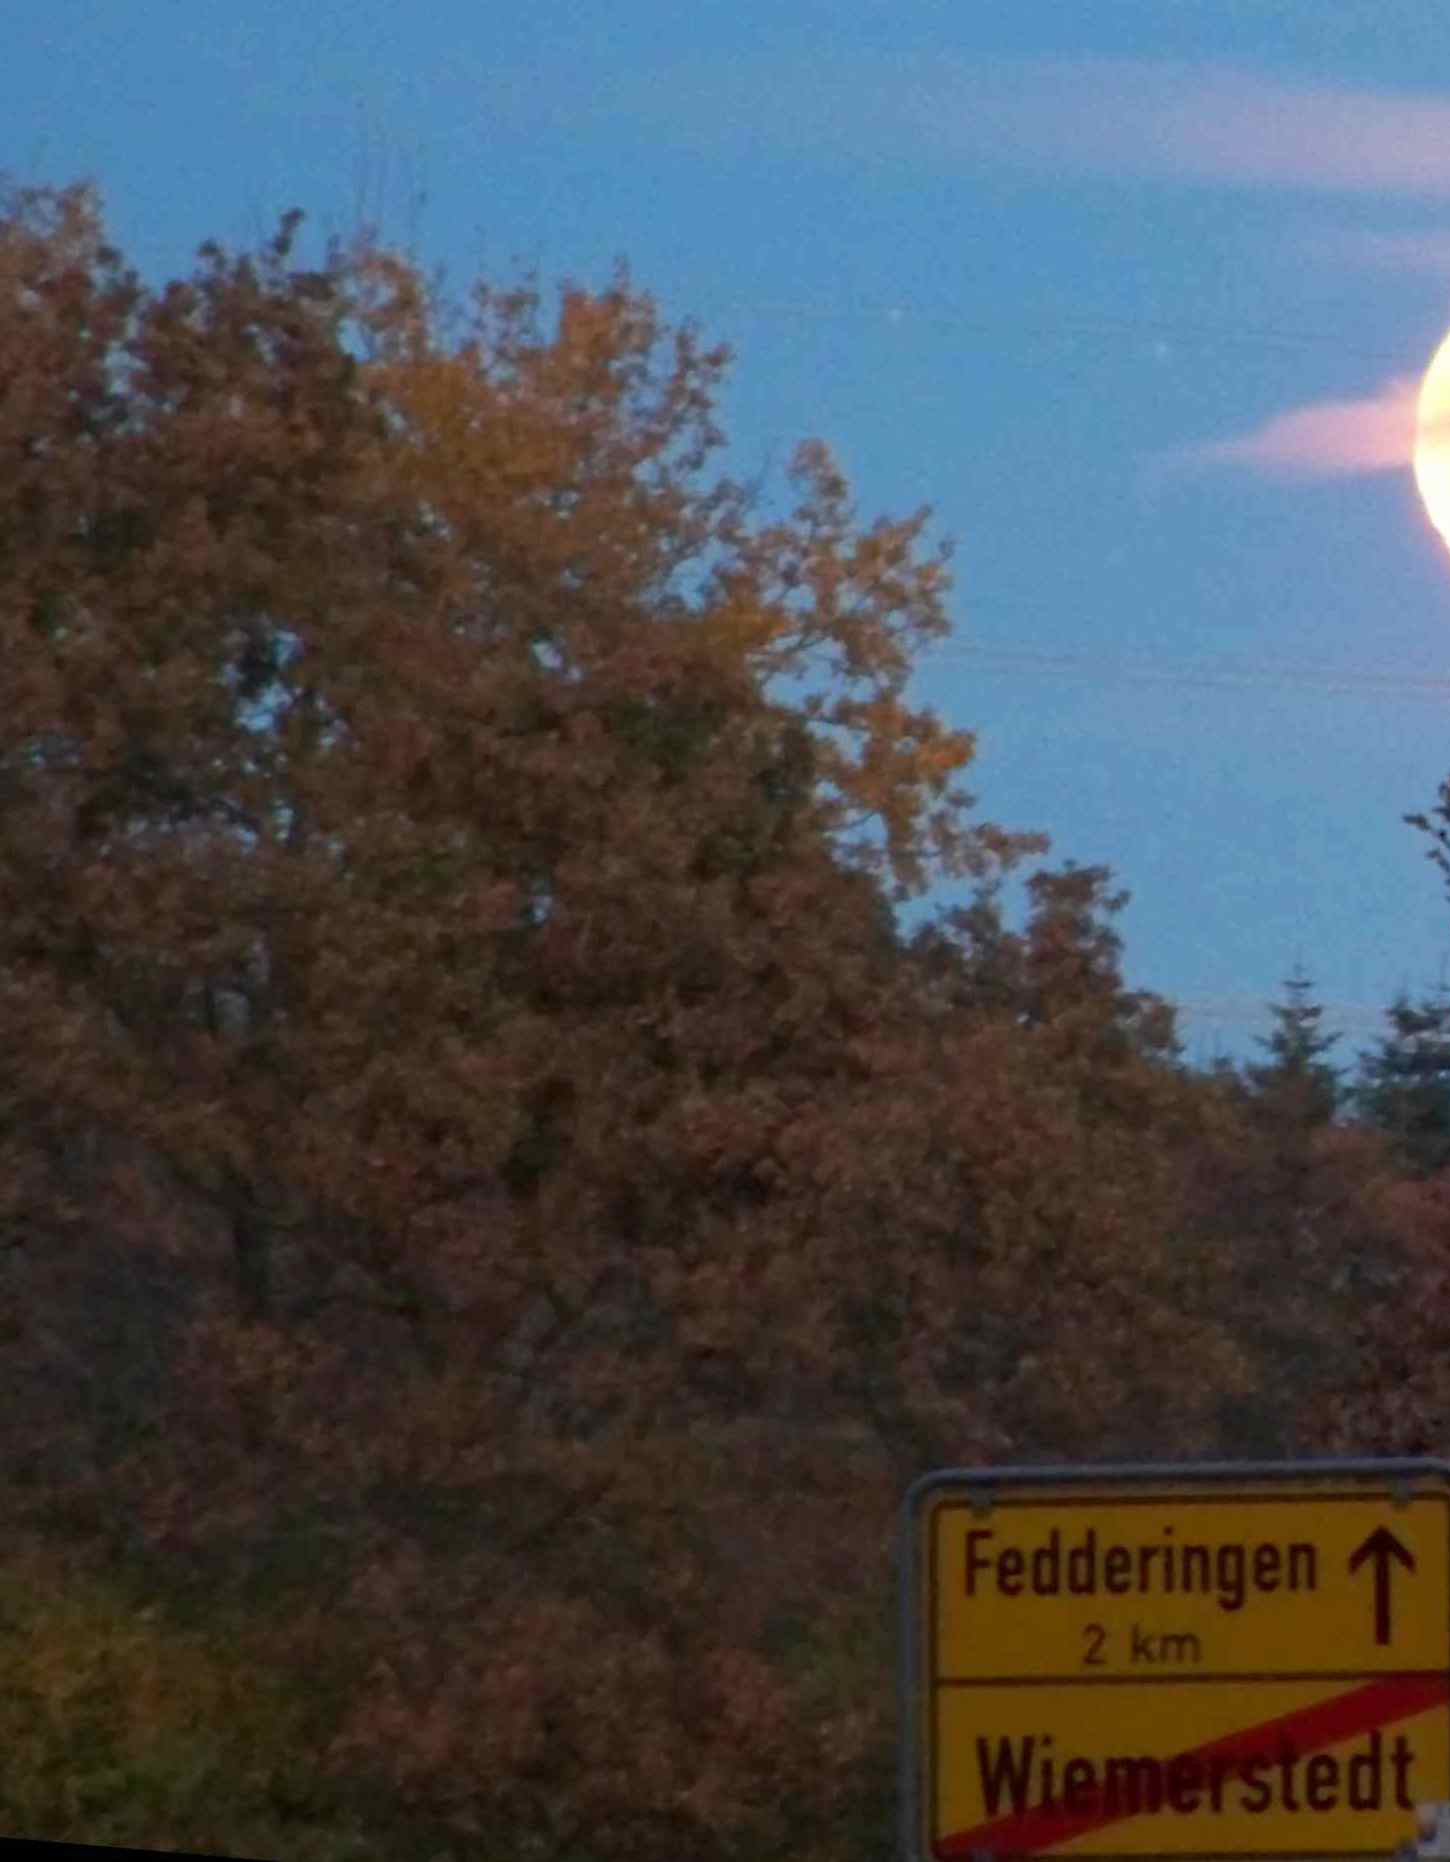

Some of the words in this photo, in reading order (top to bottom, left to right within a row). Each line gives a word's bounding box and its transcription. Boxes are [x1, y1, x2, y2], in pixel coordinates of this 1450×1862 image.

[964, 1527, 1318, 1611] Fedderingen
[1083, 1623, 1107, 1665] 2
[1130, 1624, 1203, 1664] km
[975, 1730, 1415, 1819] Wiemerstedt
